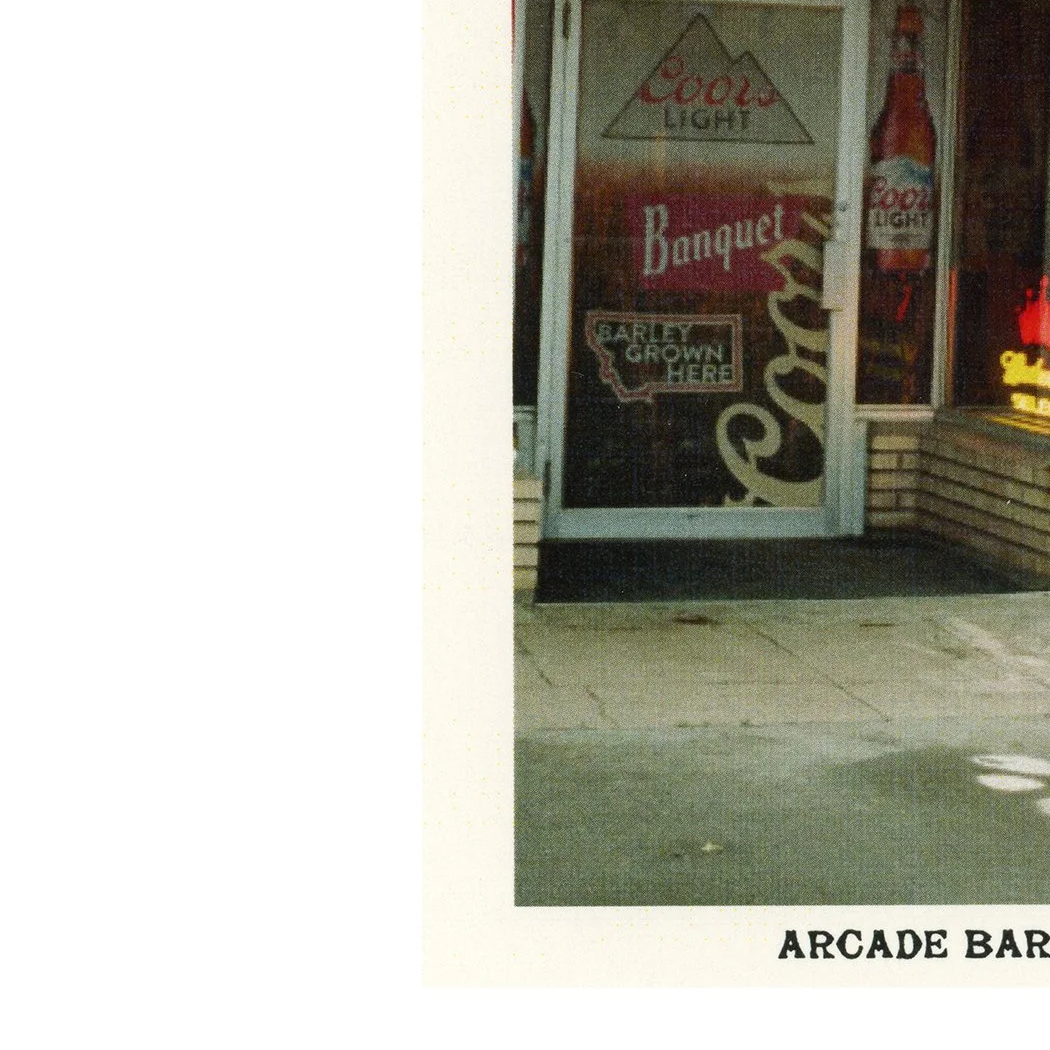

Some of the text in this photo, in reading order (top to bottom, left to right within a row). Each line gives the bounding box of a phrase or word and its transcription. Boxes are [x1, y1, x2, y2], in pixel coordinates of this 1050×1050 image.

[634, 55, 780, 109] Coors
[663, 108, 750, 132] LIGHT
[874, 211, 929, 229] LIGHT
[642, 203, 784, 278] Banquet
[597, 323, 692, 345] BARLEY
[624, 344, 725, 364] GROWN
[666, 363, 734, 384] HERE
